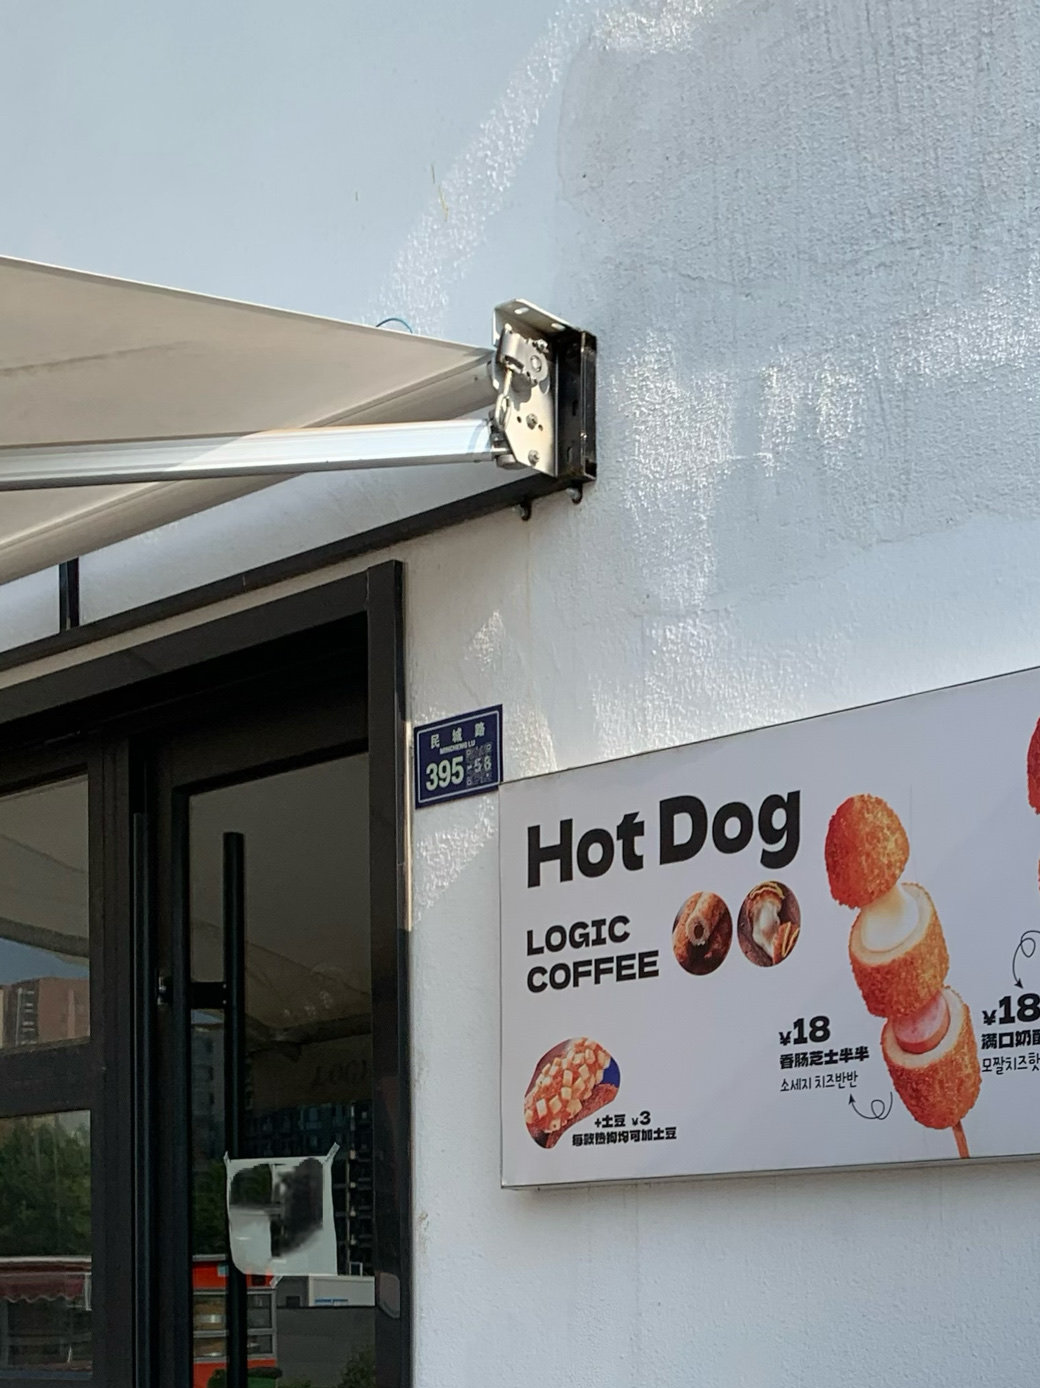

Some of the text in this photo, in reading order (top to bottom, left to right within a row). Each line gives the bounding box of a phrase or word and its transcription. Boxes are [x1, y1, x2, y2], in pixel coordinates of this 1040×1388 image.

[425, 755, 464, 791] 395
[528, 791, 800, 888] Hot Dog
[527, 915, 631, 956] LOGIC
[527, 948, 659, 993] COFFEE
[982, 993, 1040, 1025] ¥18
[779, 1016, 830, 1046] ¥18
[779, 1045, 870, 1069] 香肠芝士半半
[780, 1070, 859, 1092] 소세지 치즈반반
